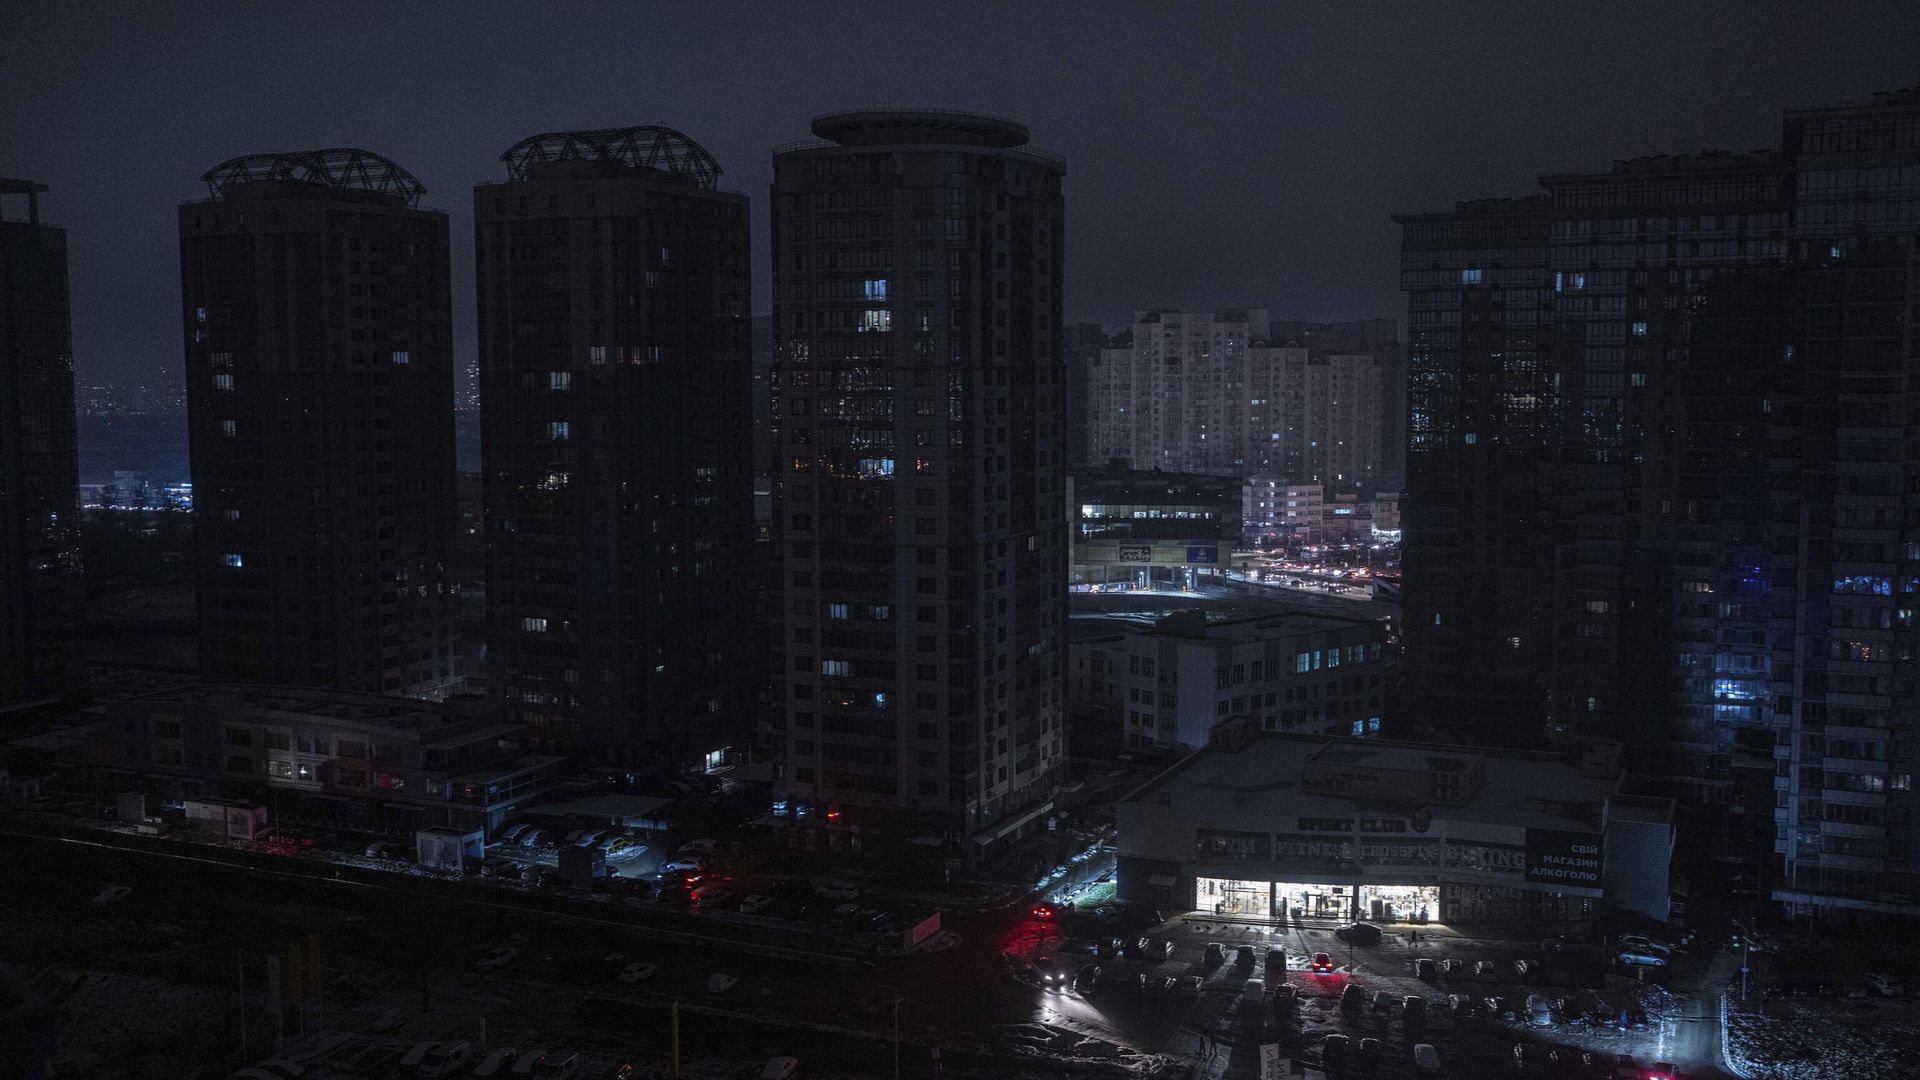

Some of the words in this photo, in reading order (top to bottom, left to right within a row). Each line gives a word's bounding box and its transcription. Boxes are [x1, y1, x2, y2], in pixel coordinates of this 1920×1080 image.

[1297, 817, 1355, 832] SPORT
[1360, 819, 1406, 833] CLUB
[1361, 845, 1434, 858] CROSSFI
[1571, 844, 1598, 854] СВІЙ
[1543, 855, 1598, 867] МАГАЗИН
[1531, 867, 1598, 881] АЛКОГОЛЮ
